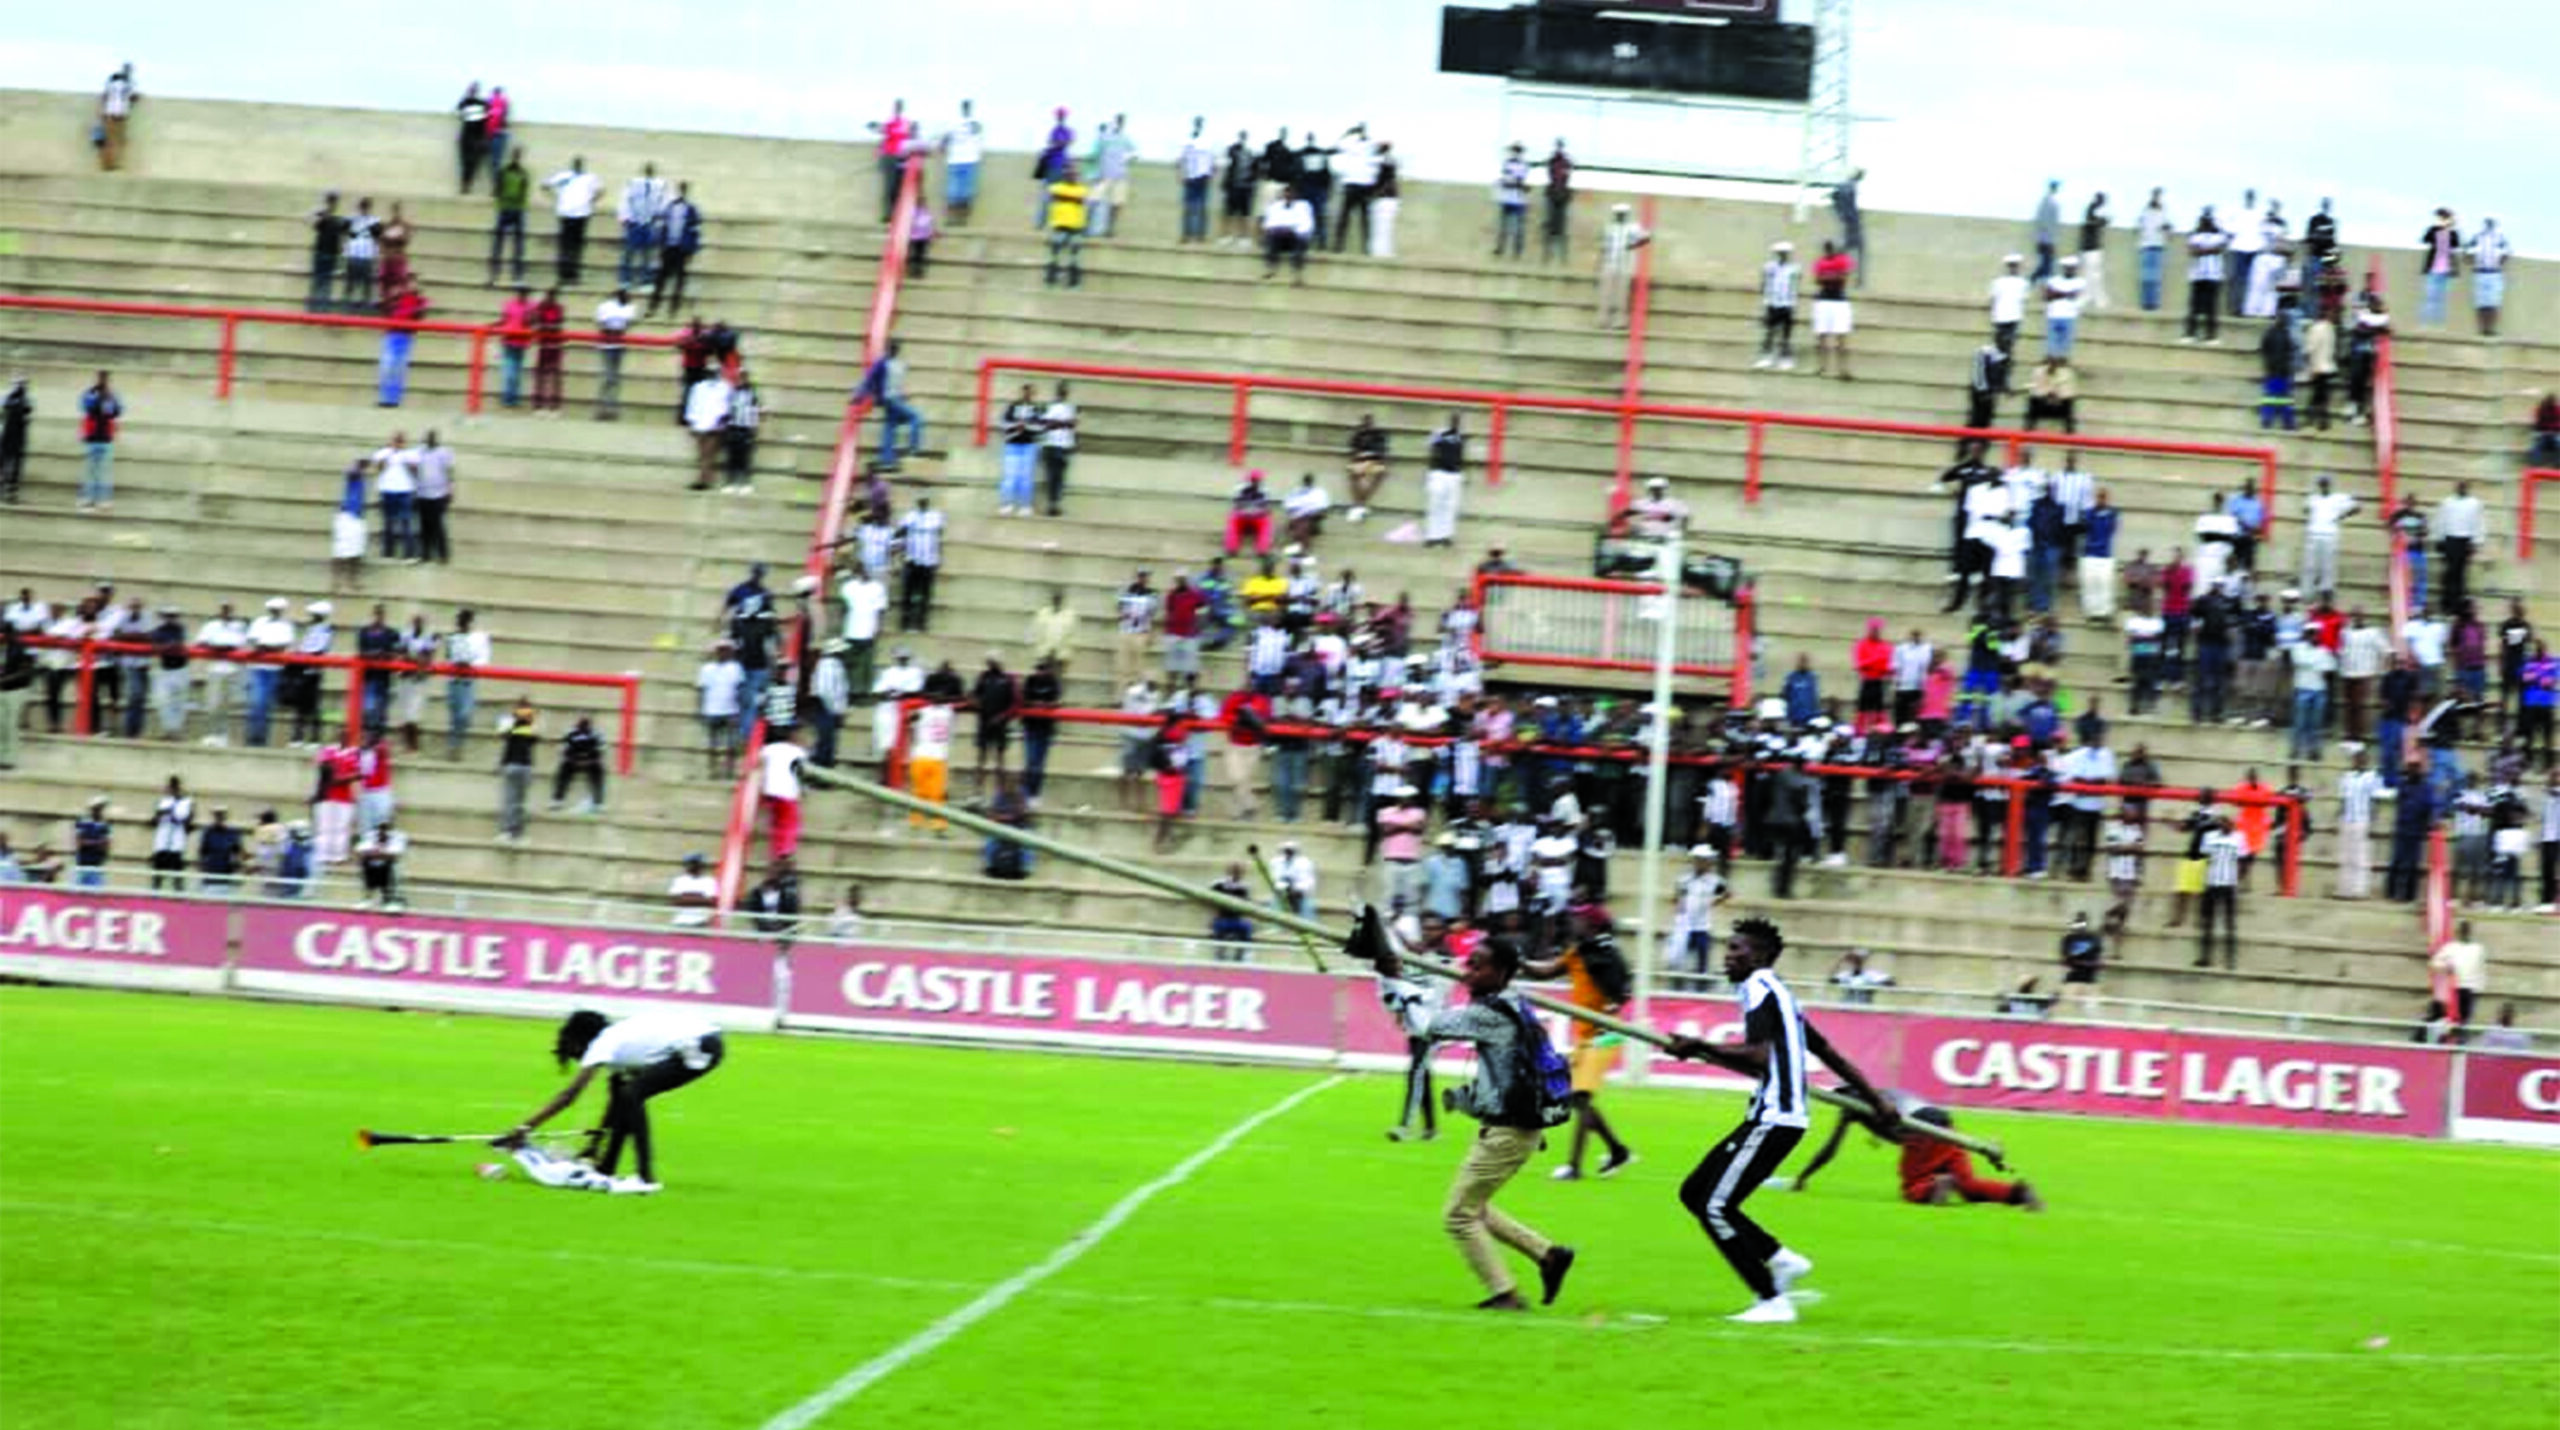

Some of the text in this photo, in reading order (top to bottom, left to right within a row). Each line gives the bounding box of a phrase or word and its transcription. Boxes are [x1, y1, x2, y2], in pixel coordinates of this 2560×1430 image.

[294, 922, 717, 994] CASTLE LAGER
[841, 962, 1268, 1032] CASTLE LAGER
[1932, 1038, 2408, 1117] CASTLE LAGER
